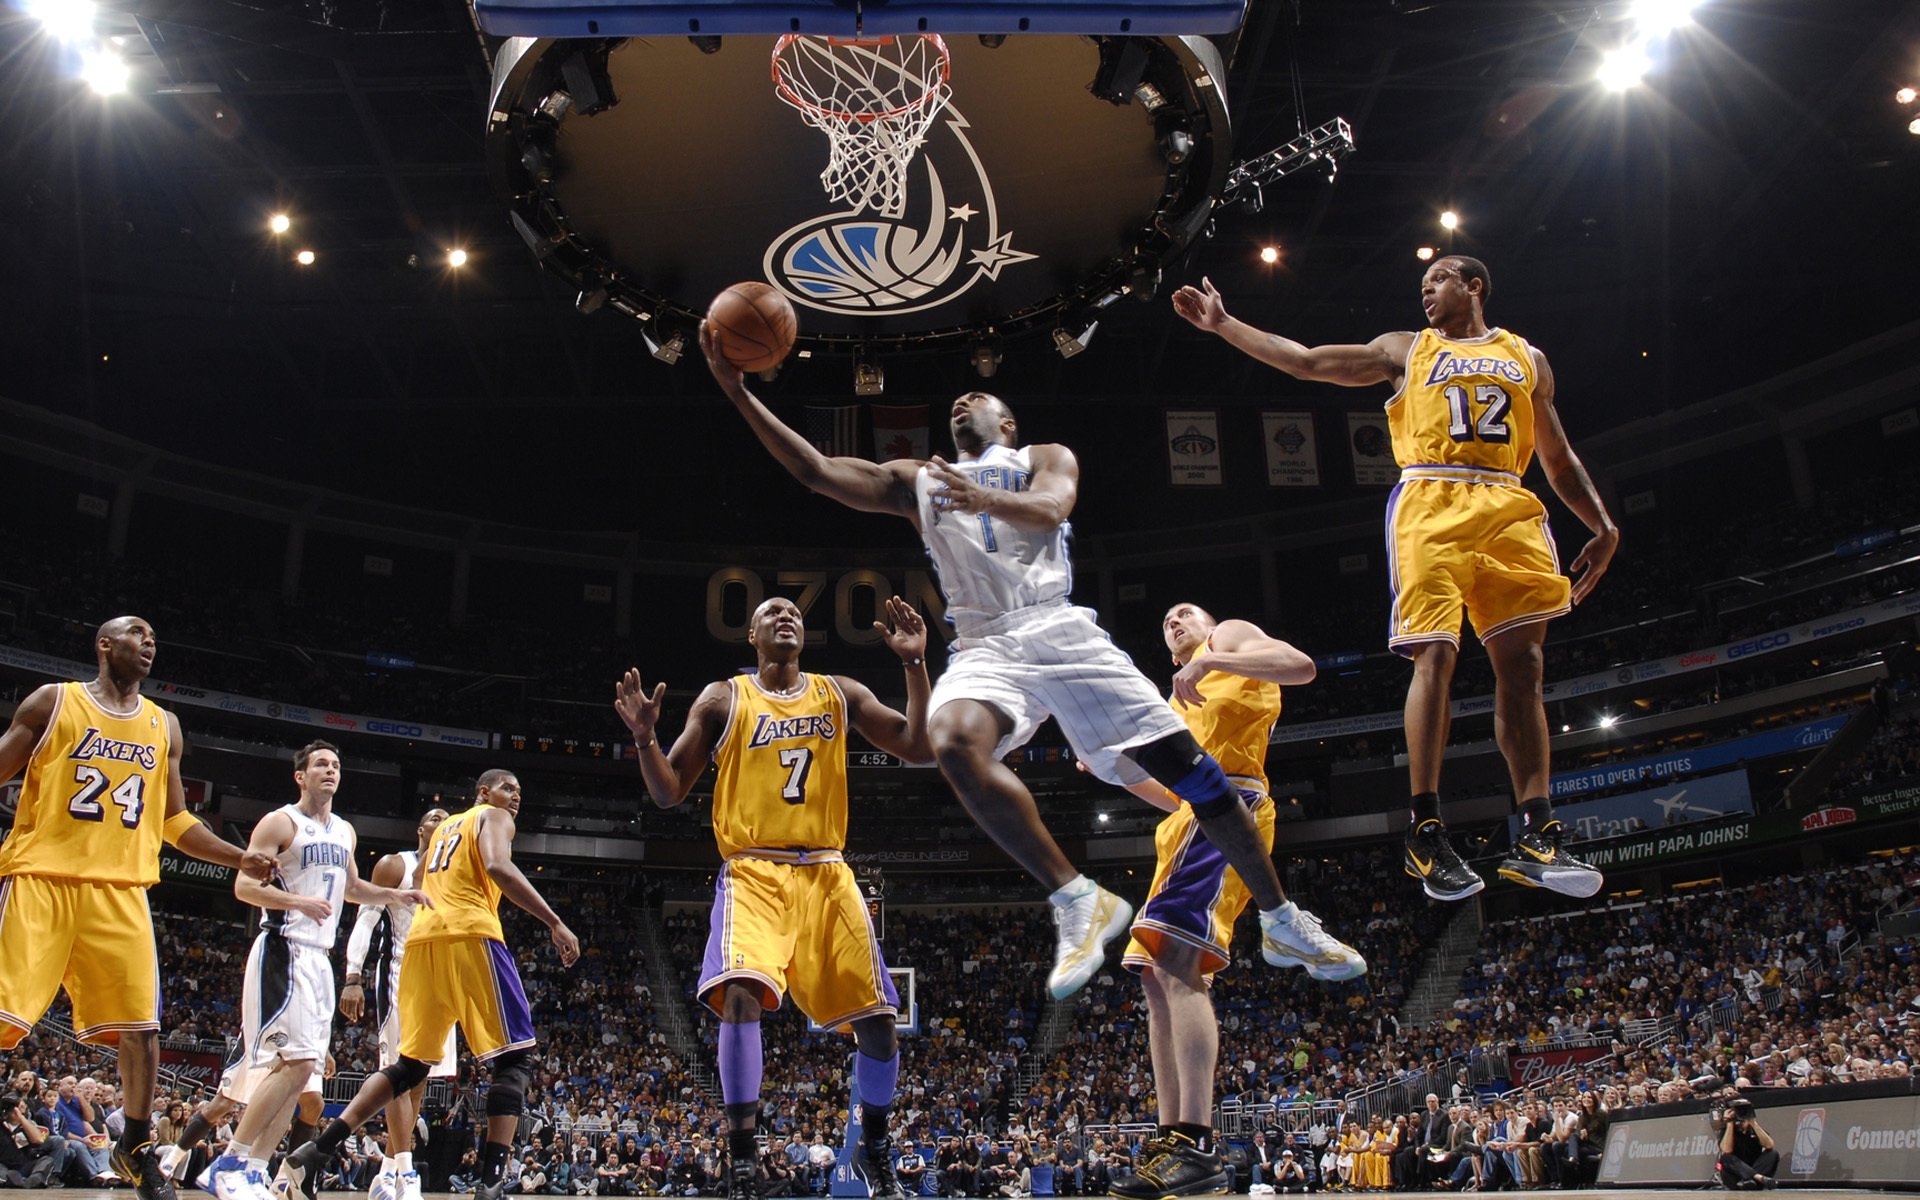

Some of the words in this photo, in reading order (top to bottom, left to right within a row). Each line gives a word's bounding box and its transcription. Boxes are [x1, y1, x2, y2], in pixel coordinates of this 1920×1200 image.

[1424, 351, 1527, 387] LAKERS
[1444, 384, 1512, 445] 12
[976, 511, 998, 553] 1
[1812, 617, 1866, 638] PEPSICO
[1727, 631, 1791, 660] GEICO
[1679, 651, 1717, 668] Disney
[156, 682, 208, 699] HARRIS
[1458, 699, 1493, 713] Amway
[323, 711, 357, 730] Disney
[366, 720, 423, 738] GEICO
[748, 711, 836, 750] LAKERS
[68, 728, 157, 771] LAKERS
[440, 734, 484, 746] PEPSICO
[859, 753, 888, 766] 4:52
[1062, 747, 1070, 760] 4
[778, 746, 814, 806] 7
[1557, 776, 1589, 794] FARES
[1591, 773, 1605, 788] TO
[1608, 768, 1637, 785] OVER
[1655, 757, 1692, 776] CITIES
[67, 763, 146, 830] 24
[1862, 792, 1893, 806] Better
[1879, 801, 1911, 814] Better
[428, 832, 463, 874] 17
[879, 850, 939, 863] BASELINE
[940, 850, 968, 862] BAR
[1585, 849, 1614, 866] WIN
[1618, 841, 1653, 860] WITH
[1658, 833, 1694, 853] PAPA
[1697, 823, 1750, 848] JOHNS!
[160, 856, 179, 871] PA
[180, 860, 230, 880] JOHNS!
[322, 872, 335, 901] 7
[1628, 1137, 1676, 1160] Connect
[1675, 1136, 1690, 1156] at
